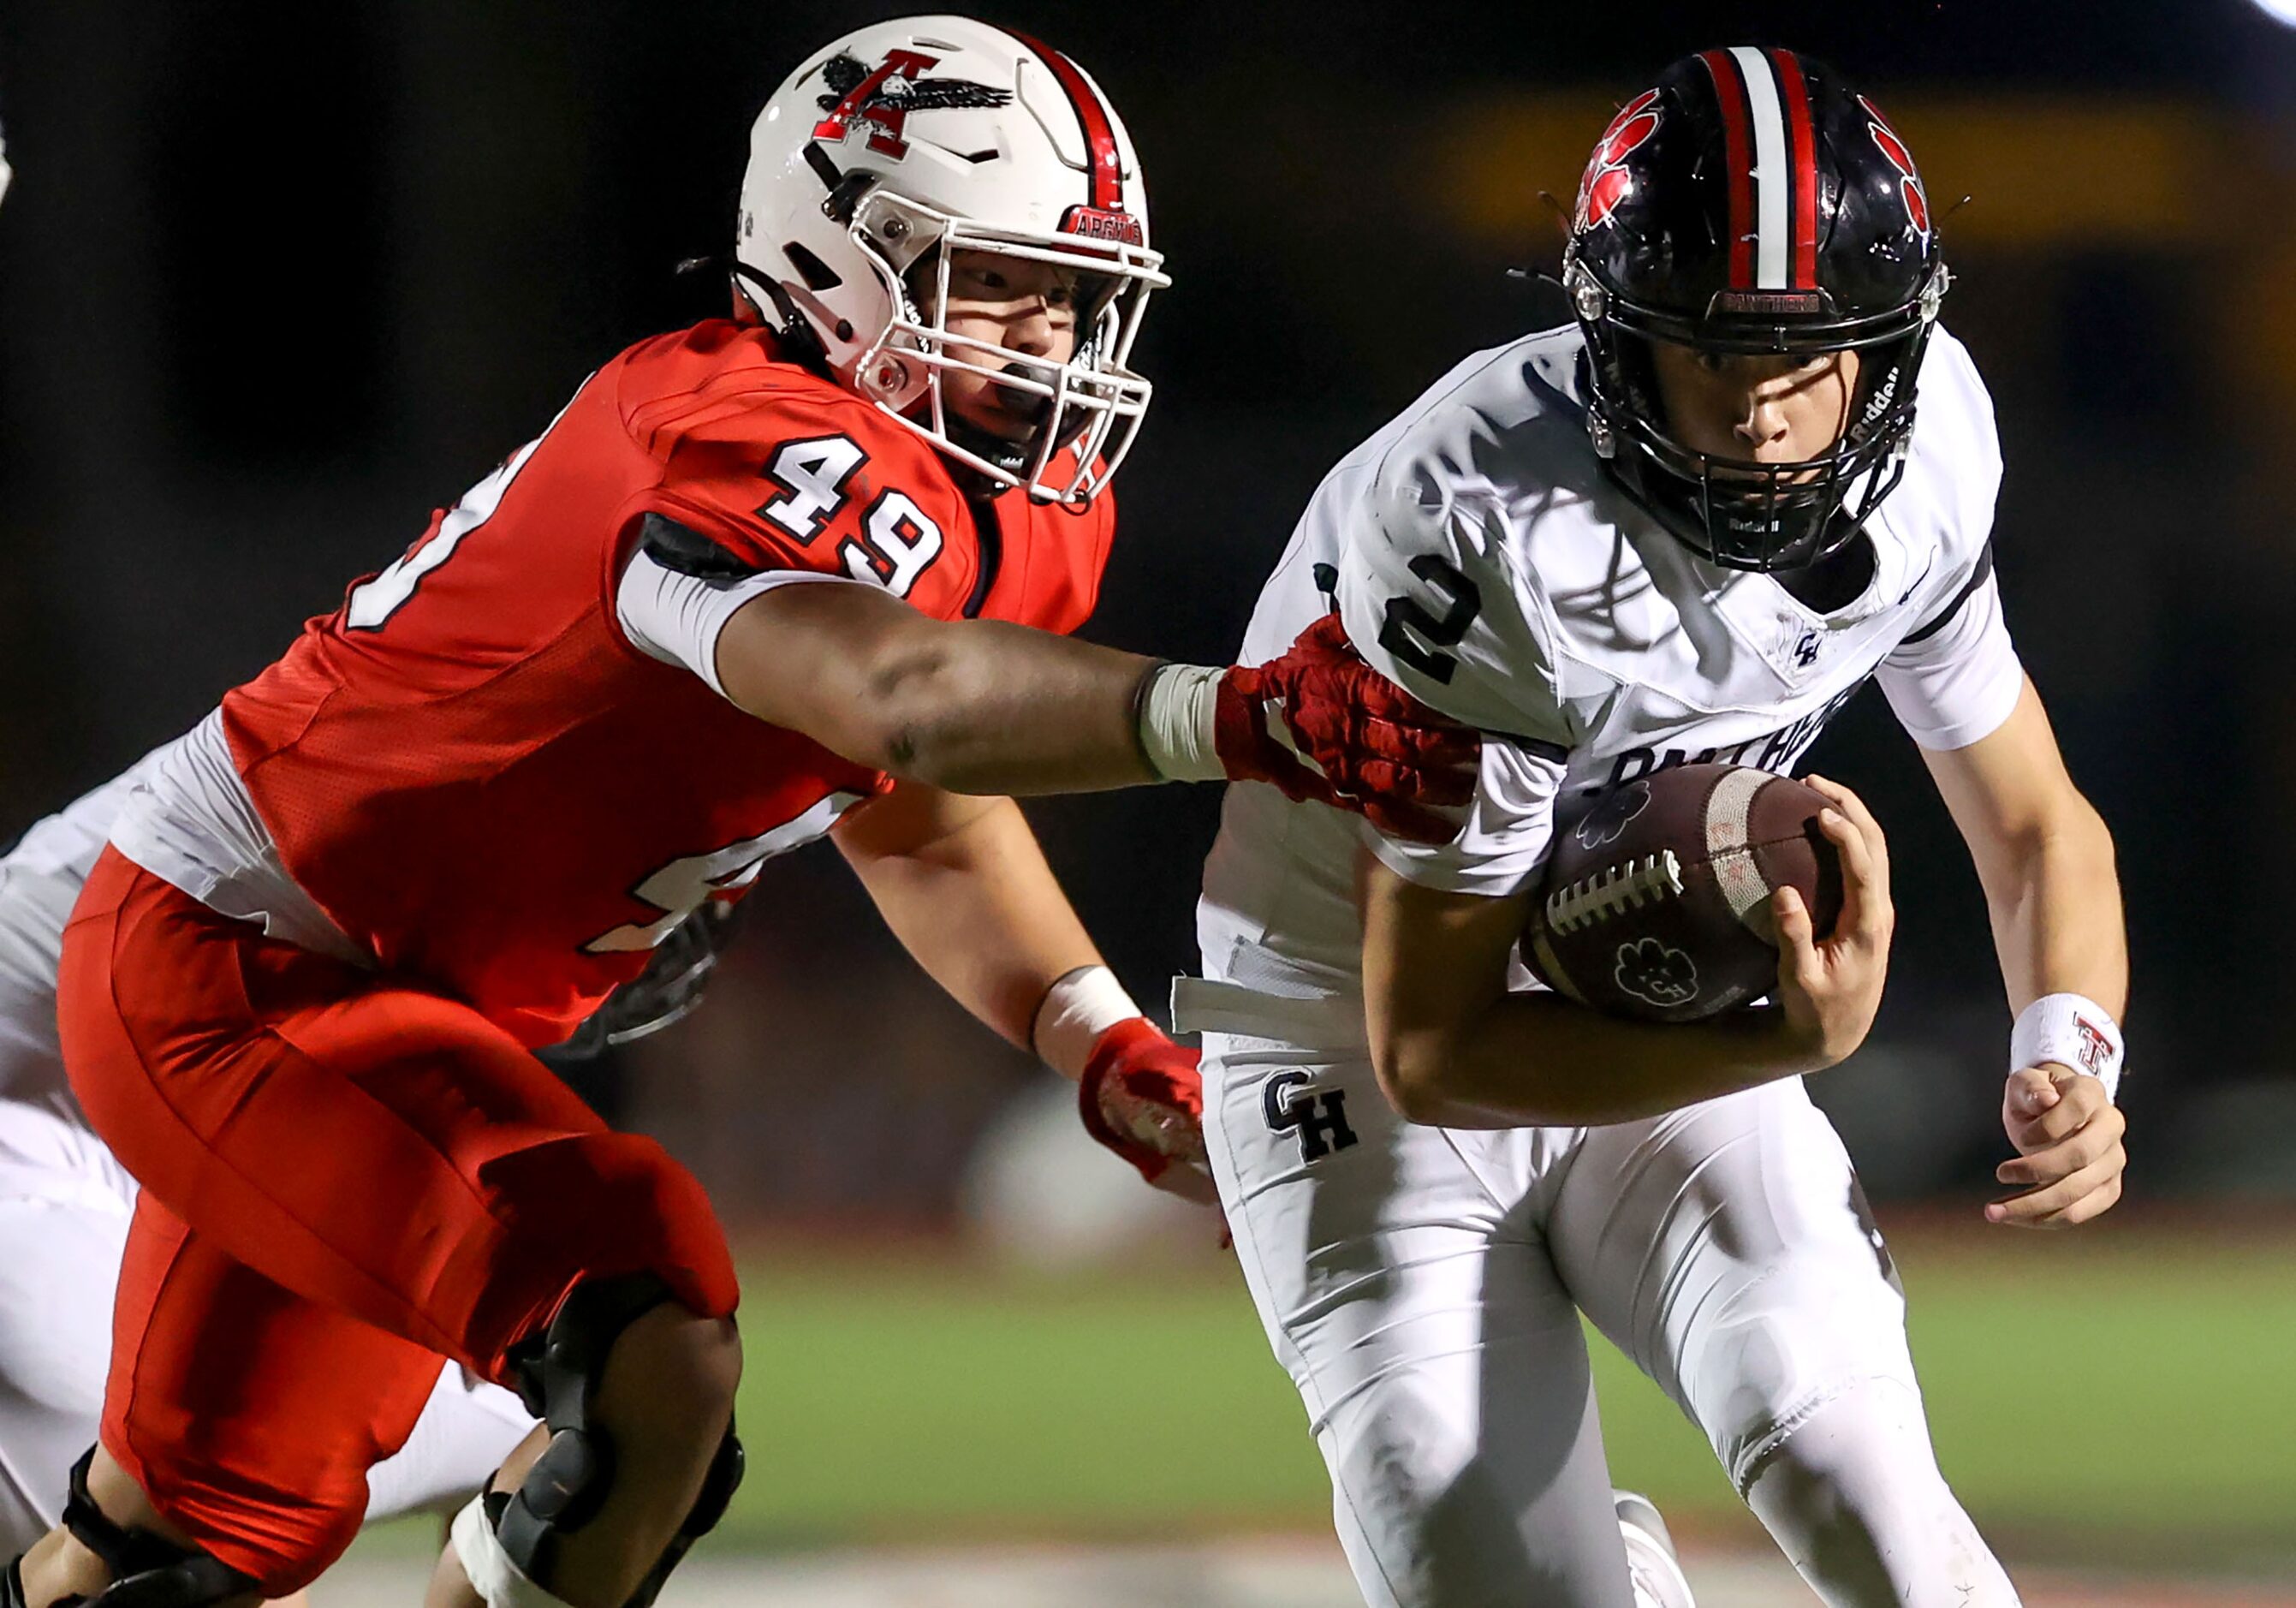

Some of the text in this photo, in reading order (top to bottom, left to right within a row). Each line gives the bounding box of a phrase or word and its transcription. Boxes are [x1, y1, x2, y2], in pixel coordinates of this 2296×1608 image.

[813, 49, 941, 161] A
[1723, 294, 1819, 313] PANTHERS
[758, 434, 942, 599] 49
[1377, 554, 1482, 685] 2
[1262, 1068, 1359, 1164] CH
